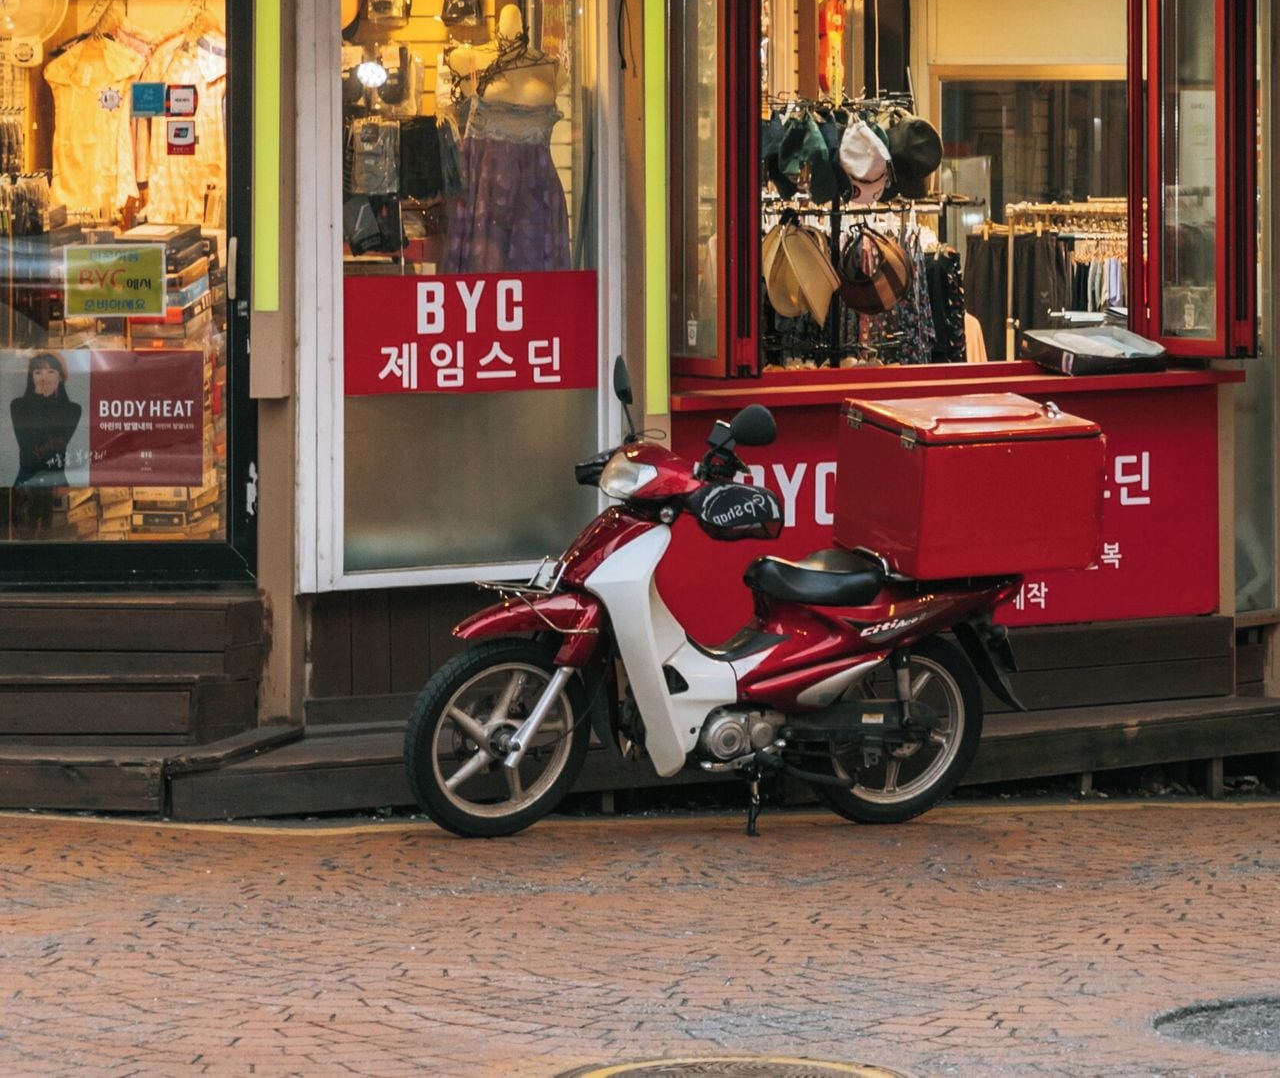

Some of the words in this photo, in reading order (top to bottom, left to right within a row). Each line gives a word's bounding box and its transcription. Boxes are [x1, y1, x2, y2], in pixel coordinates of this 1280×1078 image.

[416, 279, 523, 334] BYC
[378, 337, 562, 389] 제임스딘
[99, 400, 145, 417] BODY
[150, 400, 194, 417] HEAT
